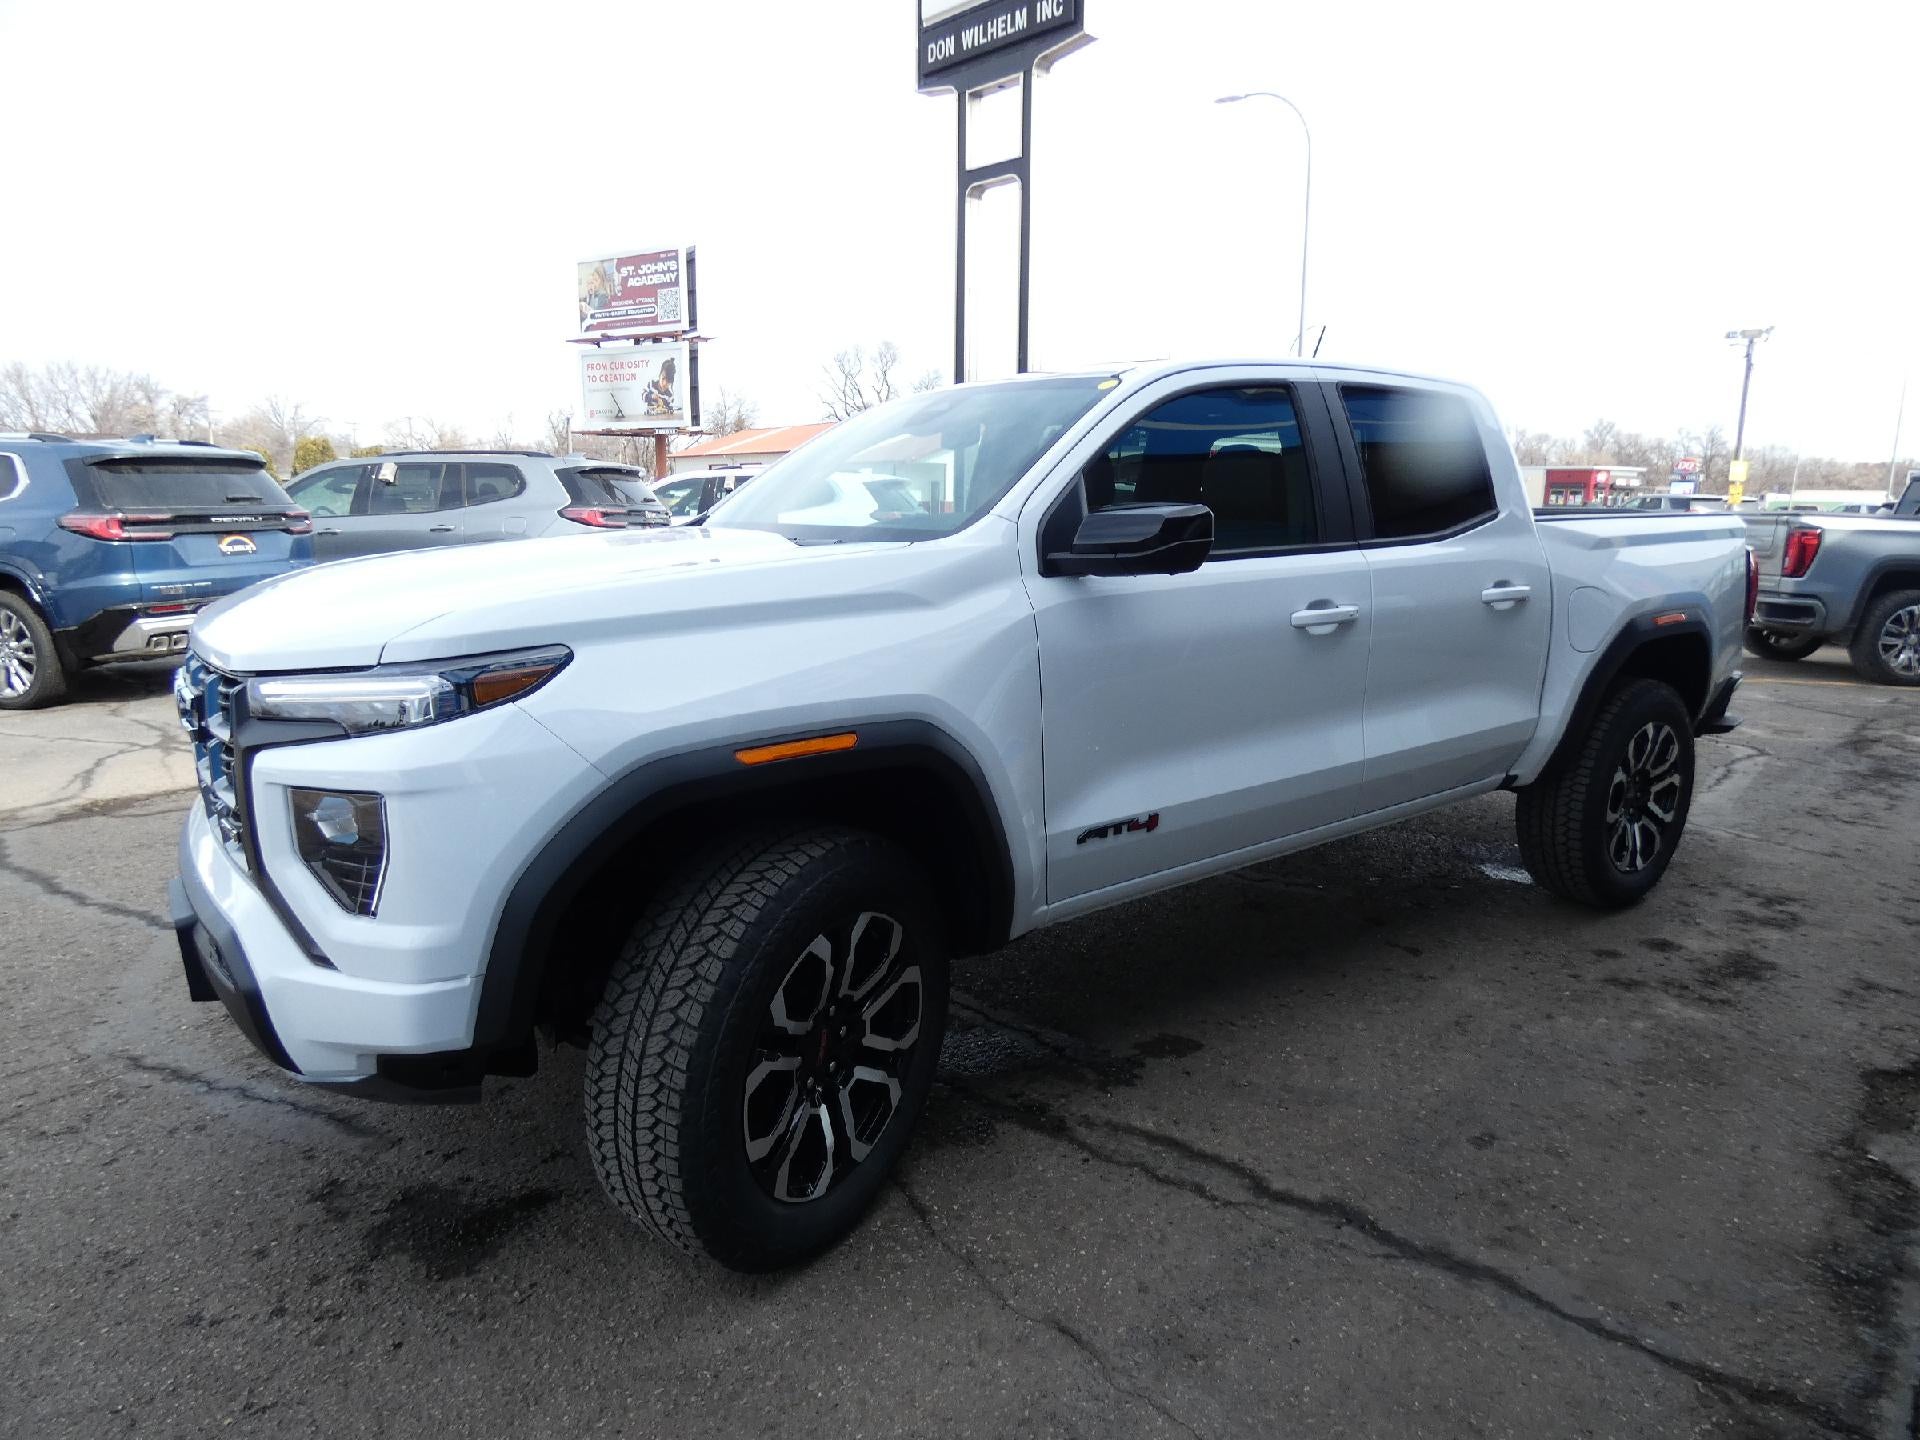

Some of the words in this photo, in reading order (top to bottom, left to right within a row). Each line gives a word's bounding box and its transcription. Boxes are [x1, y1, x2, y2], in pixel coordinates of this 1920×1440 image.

[928, 35, 955, 64] DON
[961, 7, 1027, 51] WILHELM
[1036, 0, 1064, 23] INC
[638, 261, 677, 274] JOHN'S
[628, 273, 677, 287] ACADEMY
[587, 362, 607, 371] FROM
[609, 360, 650, 370] CURIOSITY
[587, 375, 597, 383] TO
[599, 373, 637, 382] CREATION
[1077, 812, 1159, 844] AT4
